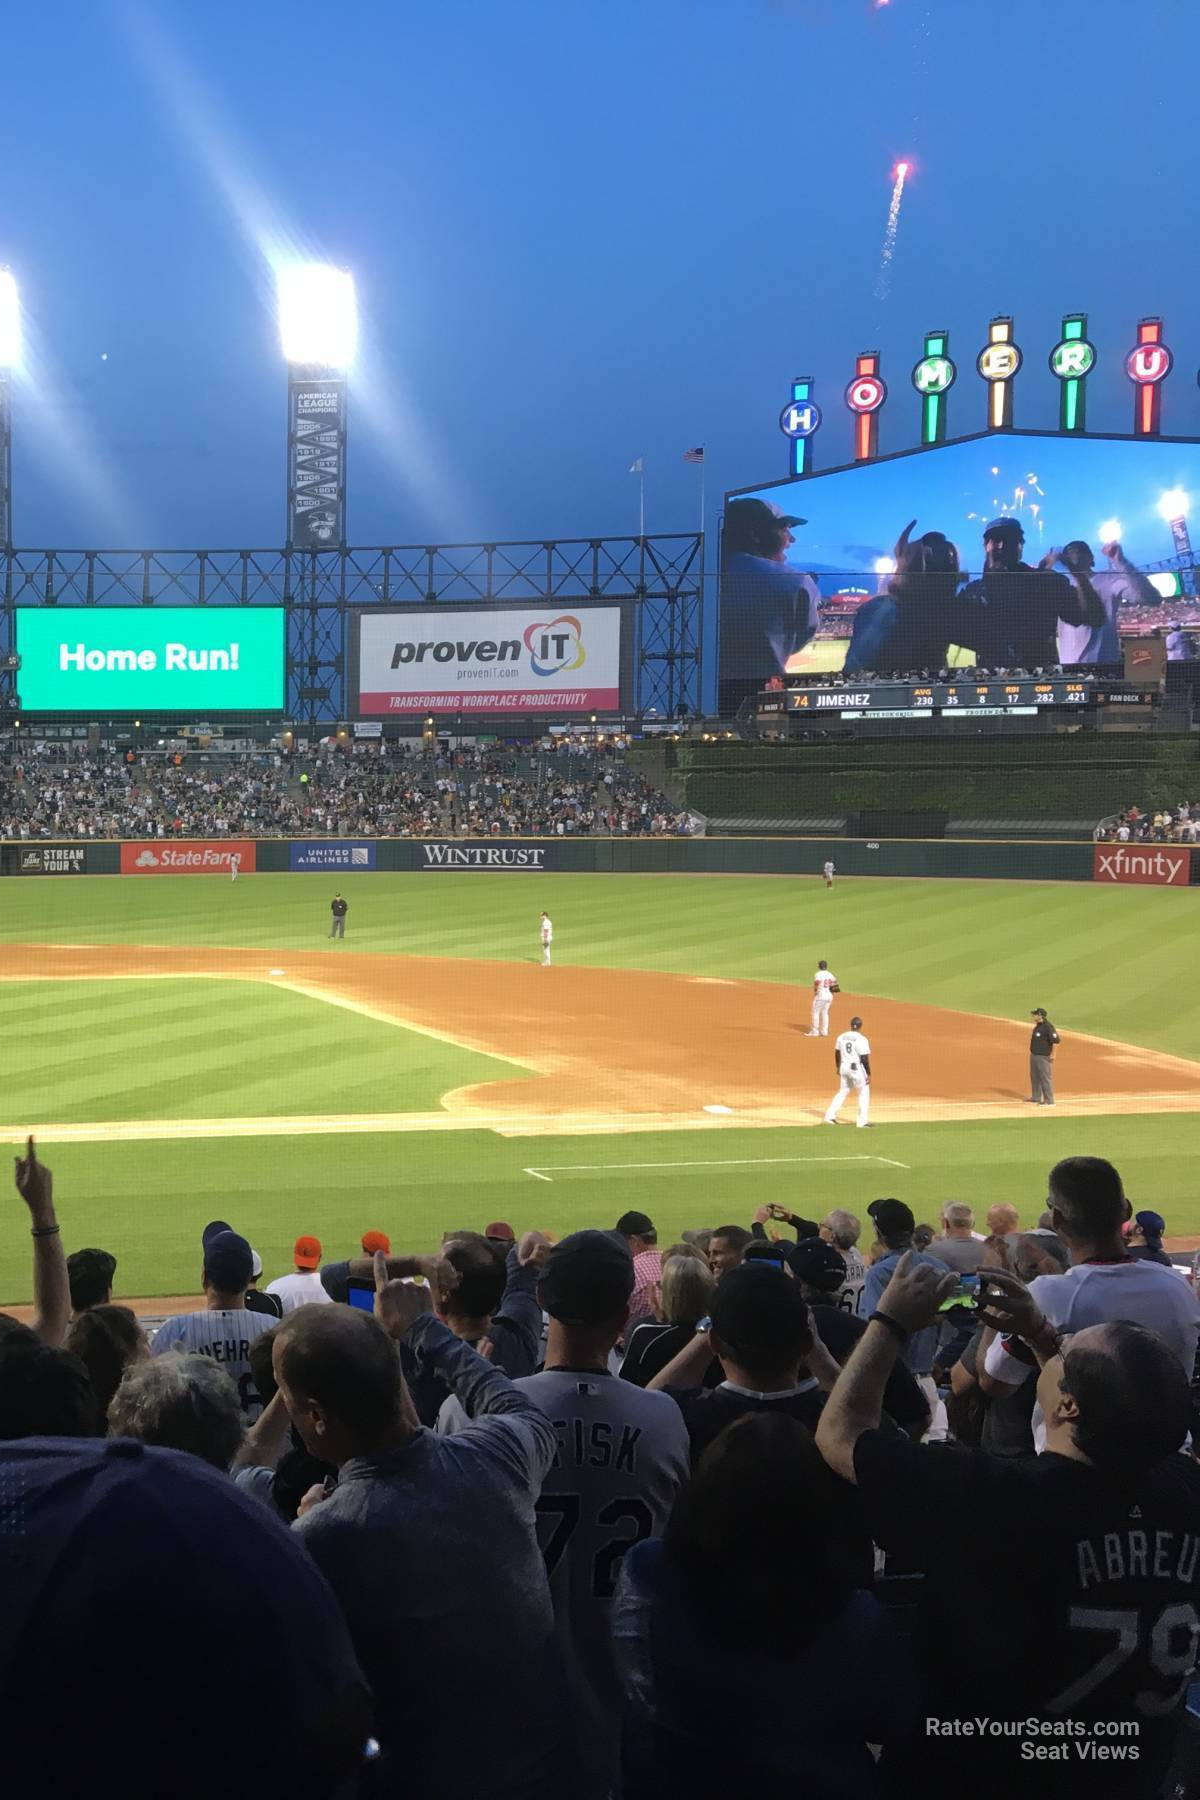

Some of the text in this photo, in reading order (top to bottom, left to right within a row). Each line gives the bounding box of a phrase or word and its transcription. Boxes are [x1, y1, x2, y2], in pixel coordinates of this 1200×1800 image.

[297, 392, 338, 400] AMERICAN
[297, 399, 337, 408] LEAGUE
[59, 643, 240, 671] Home Run!
[390, 634, 570, 669] proven IT
[457, 667, 519, 680] provenIT.com
[914, 688, 932, 696] AVG
[1005, 686, 1020, 694] RBI
[1035, 685, 1052, 693] OBP
[1110, 694, 1140, 702] FAN DECK
[389, 692, 587, 709] TRANSFORMING WORKPLACE PRODUCTIVITY
[793, 692, 1086, 708] 74 JIMENEZ .230 35 8 17 .282 .421
[43, 849, 84, 860] STREAM
[423, 844, 545, 864] WINTRUST
[43, 860, 69, 871] YOUR
[1099, 849, 1183, 883] xfinity
[552, 1417, 642, 1476] FISK
[1077, 1529, 1200, 1589] ABREU
[1044, 1603, 1200, 1717] 79
